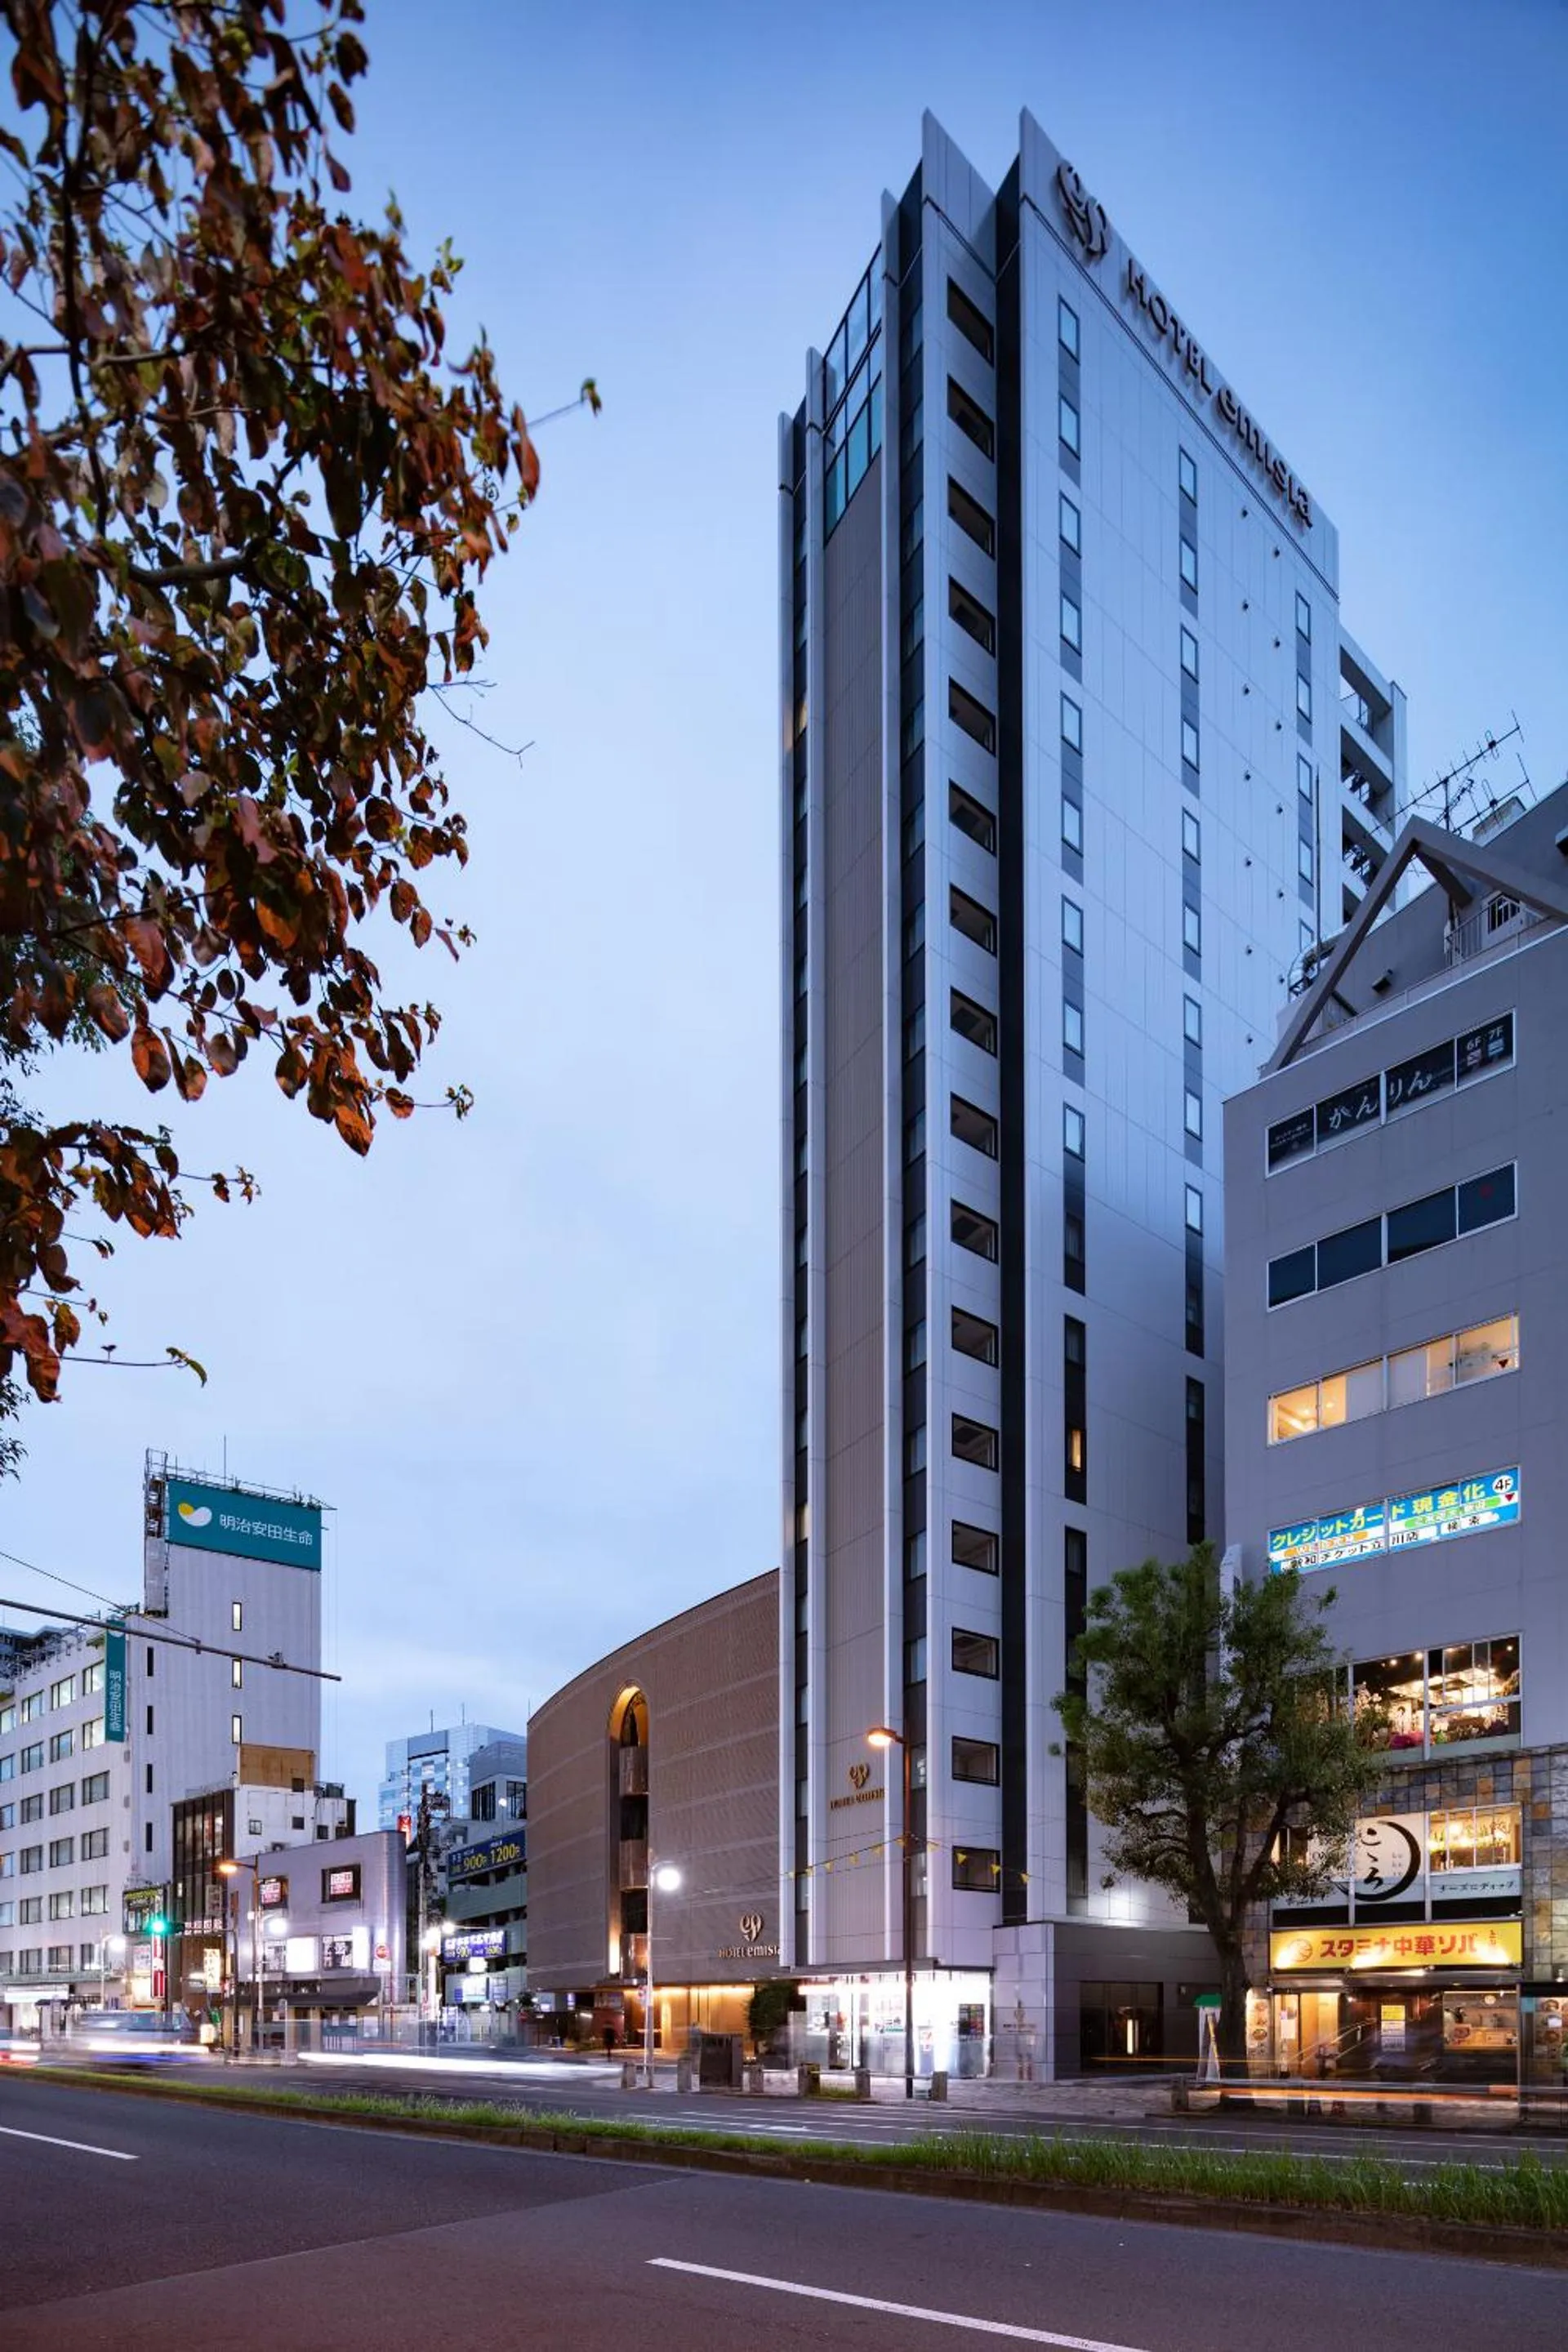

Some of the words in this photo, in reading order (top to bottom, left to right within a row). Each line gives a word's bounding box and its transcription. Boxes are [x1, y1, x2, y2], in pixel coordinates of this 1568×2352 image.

[1127, 257, 1213, 396] HOTEL
[1328, 1070, 1432, 1130] かんりん
[1494, 1478, 1512, 1492] 4F
[219, 1513, 314, 1546] 明治安田生命
